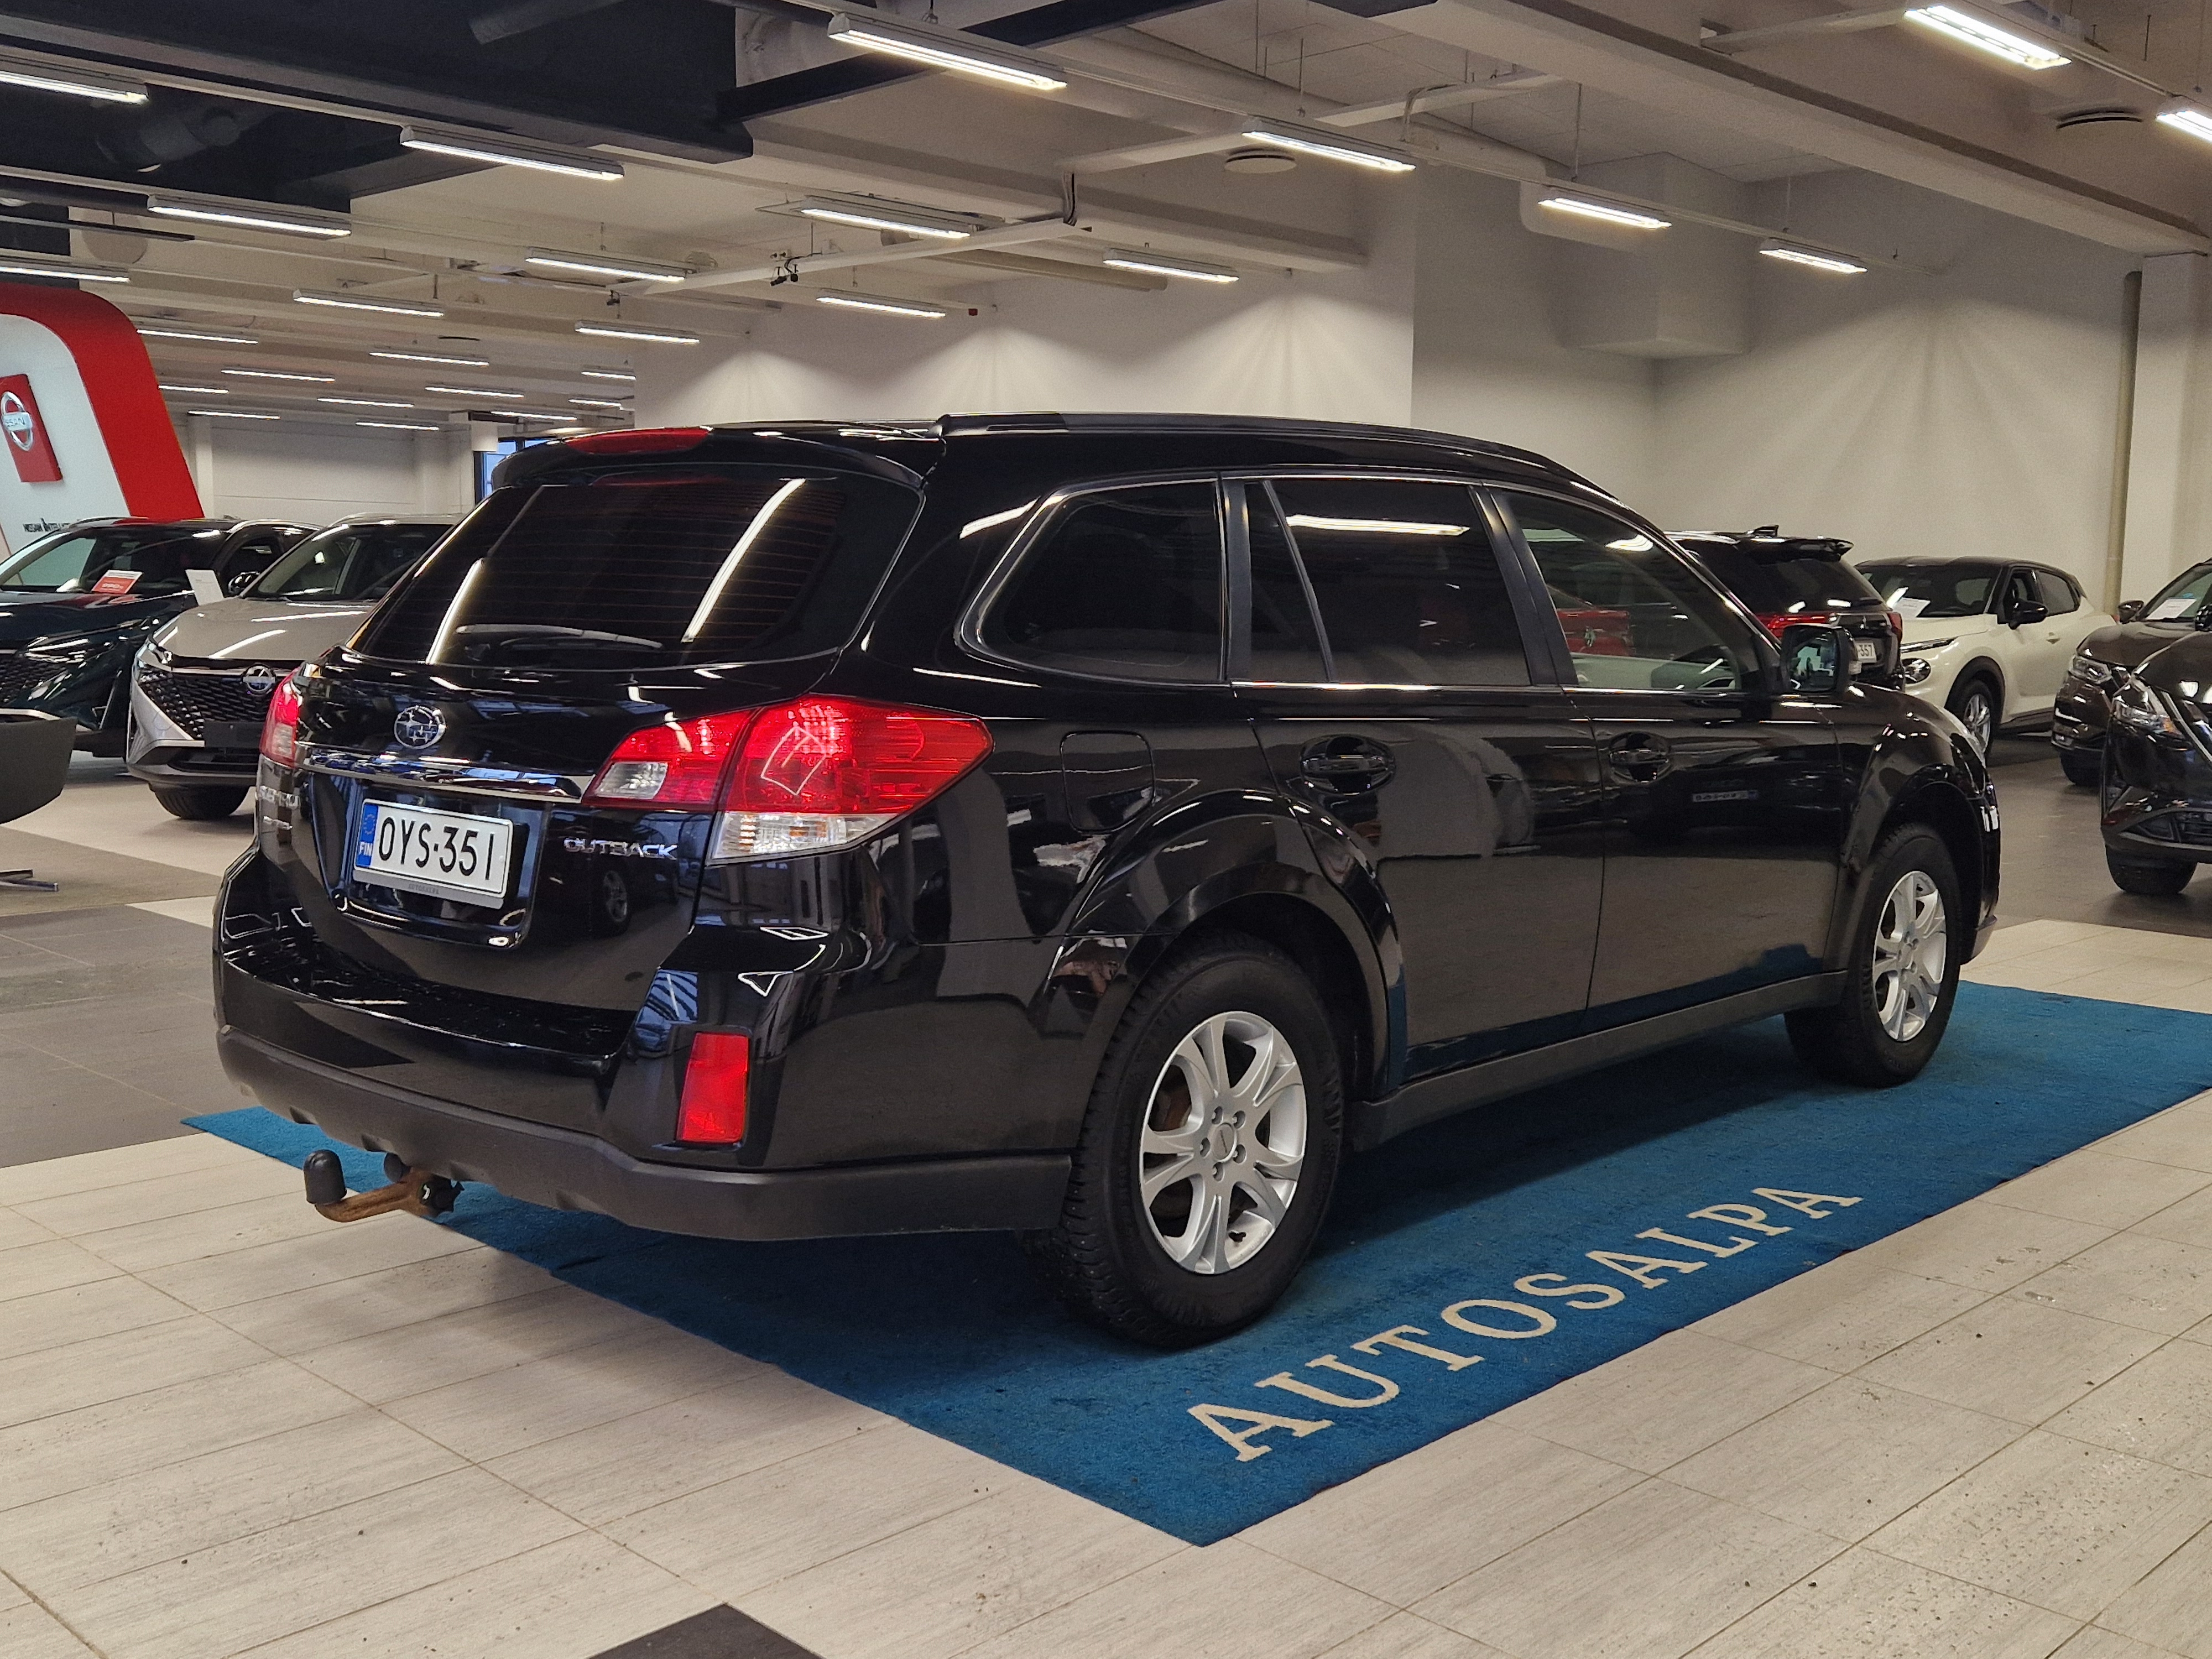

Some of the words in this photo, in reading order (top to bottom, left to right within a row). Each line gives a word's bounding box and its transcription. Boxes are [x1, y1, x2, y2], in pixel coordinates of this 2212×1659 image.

[359, 841, 373, 857] FIN
[379, 816, 495, 880] OYS-351
[564, 837, 678, 860] OUTBACK
[1187, 1186, 1864, 1463] AUTOSALPA
